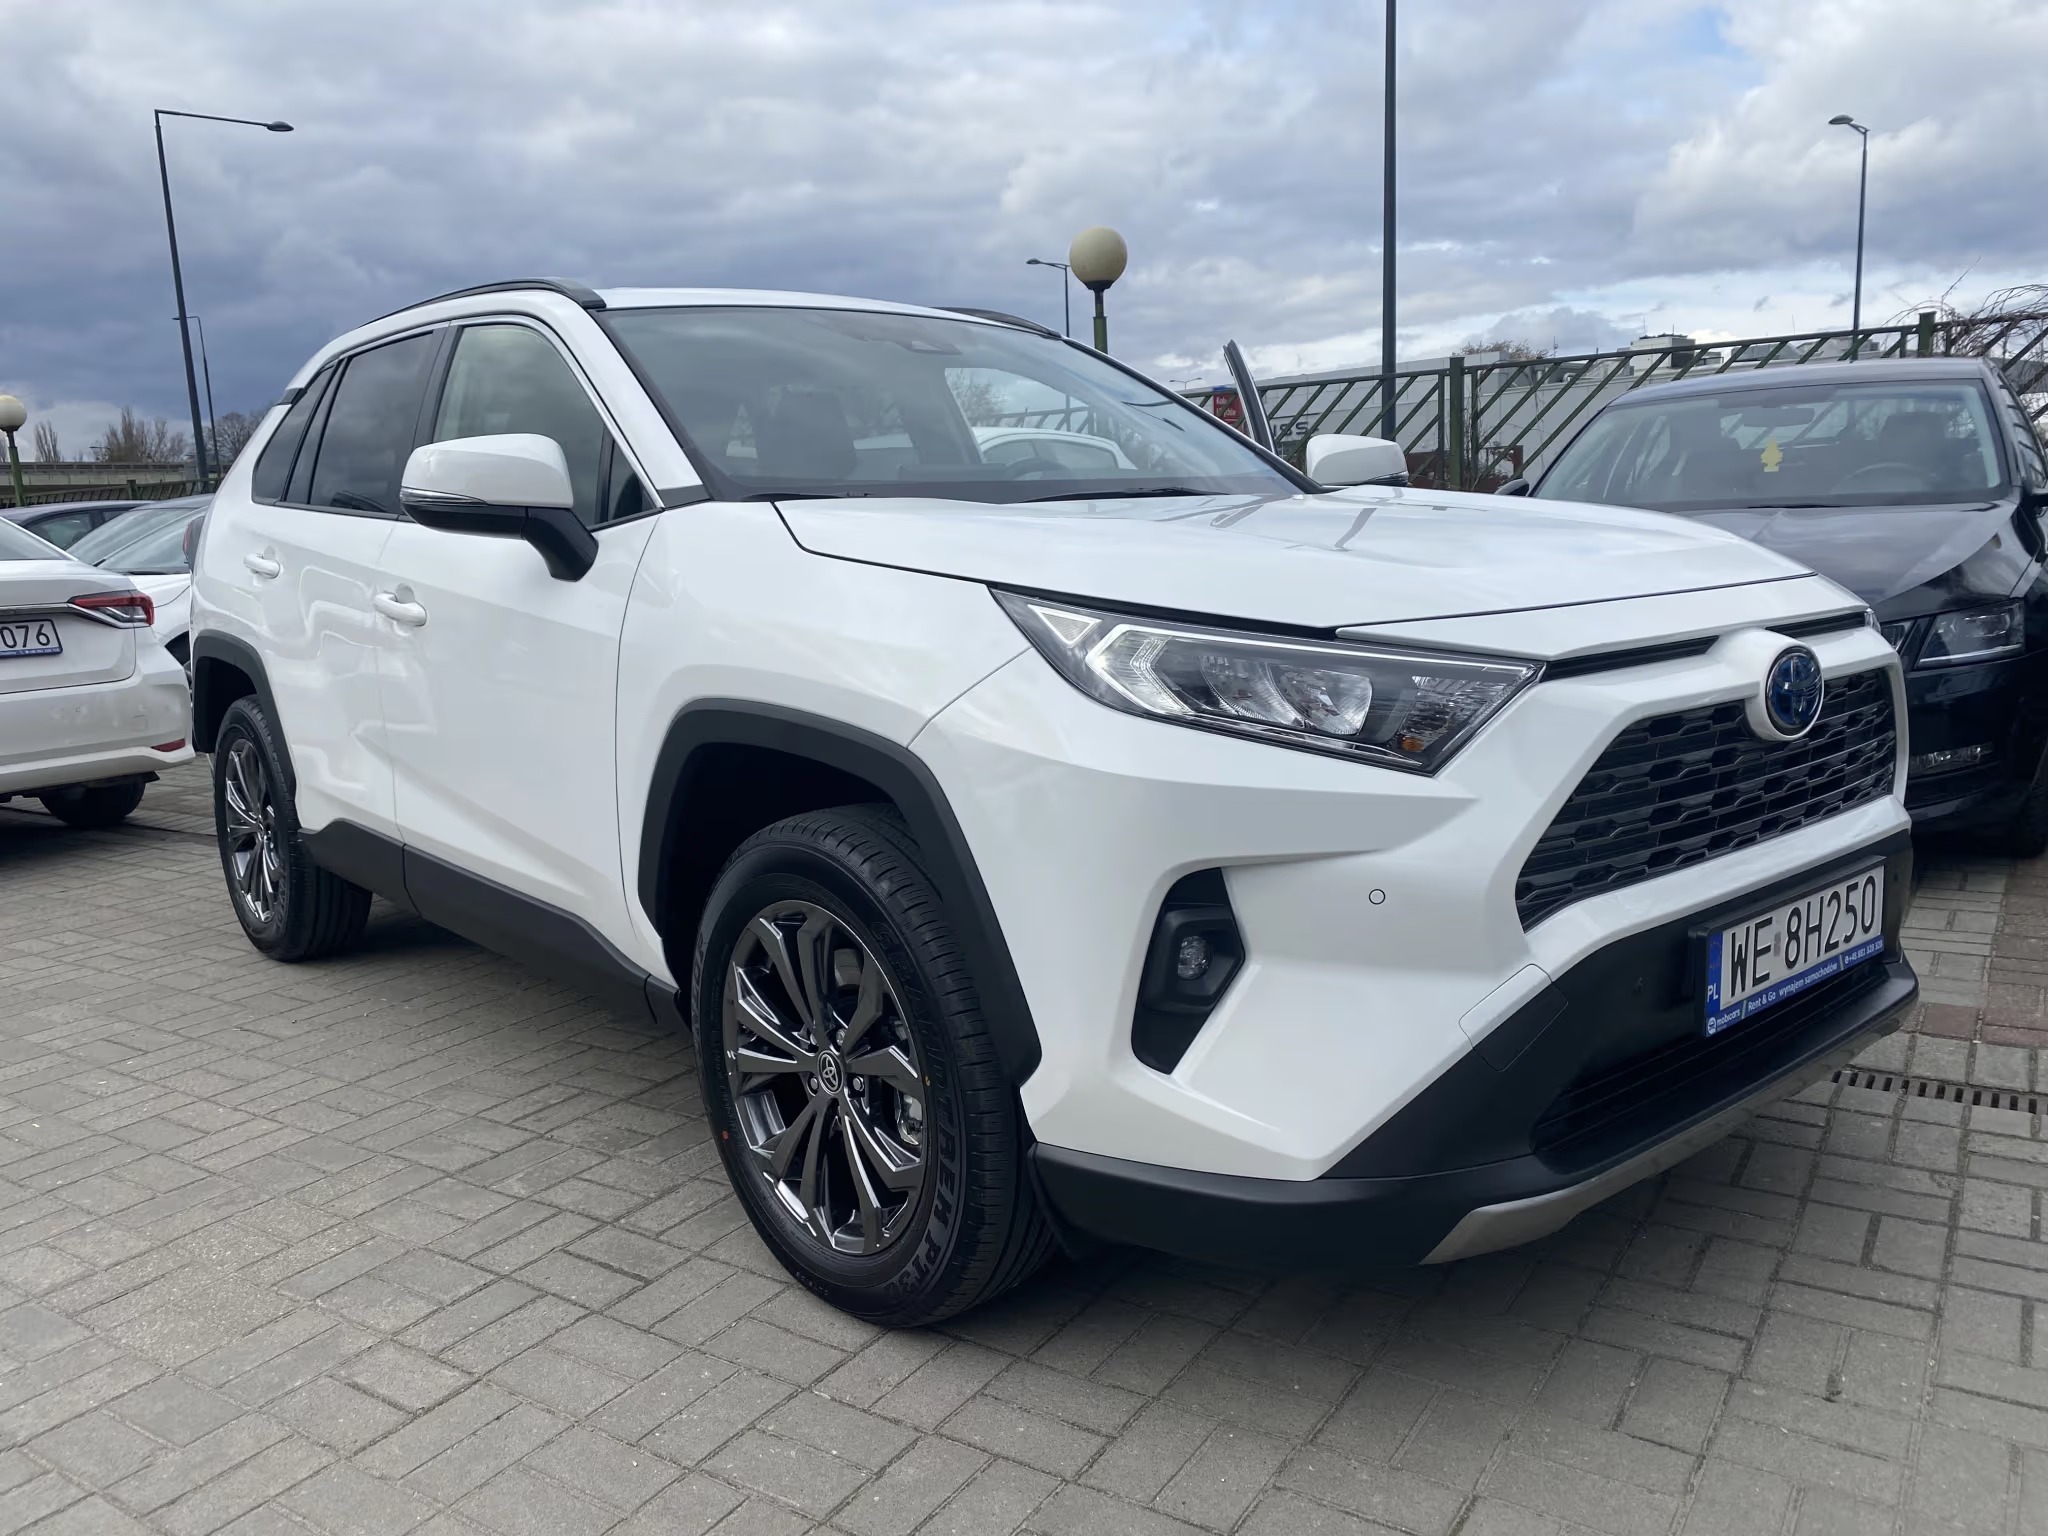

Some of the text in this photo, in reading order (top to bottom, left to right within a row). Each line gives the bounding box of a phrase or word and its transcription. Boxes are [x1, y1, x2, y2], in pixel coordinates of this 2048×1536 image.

[0, 624, 50, 648] 076
[1730, 875, 1876, 998] WE 8H250
[1706, 982, 1719, 1003] PL
[1748, 997, 1762, 1012] Rent
[1762, 993, 1767, 1005] &
[1767, 991, 1776, 1002] Go
[1779, 978, 1804, 997] wynajem
